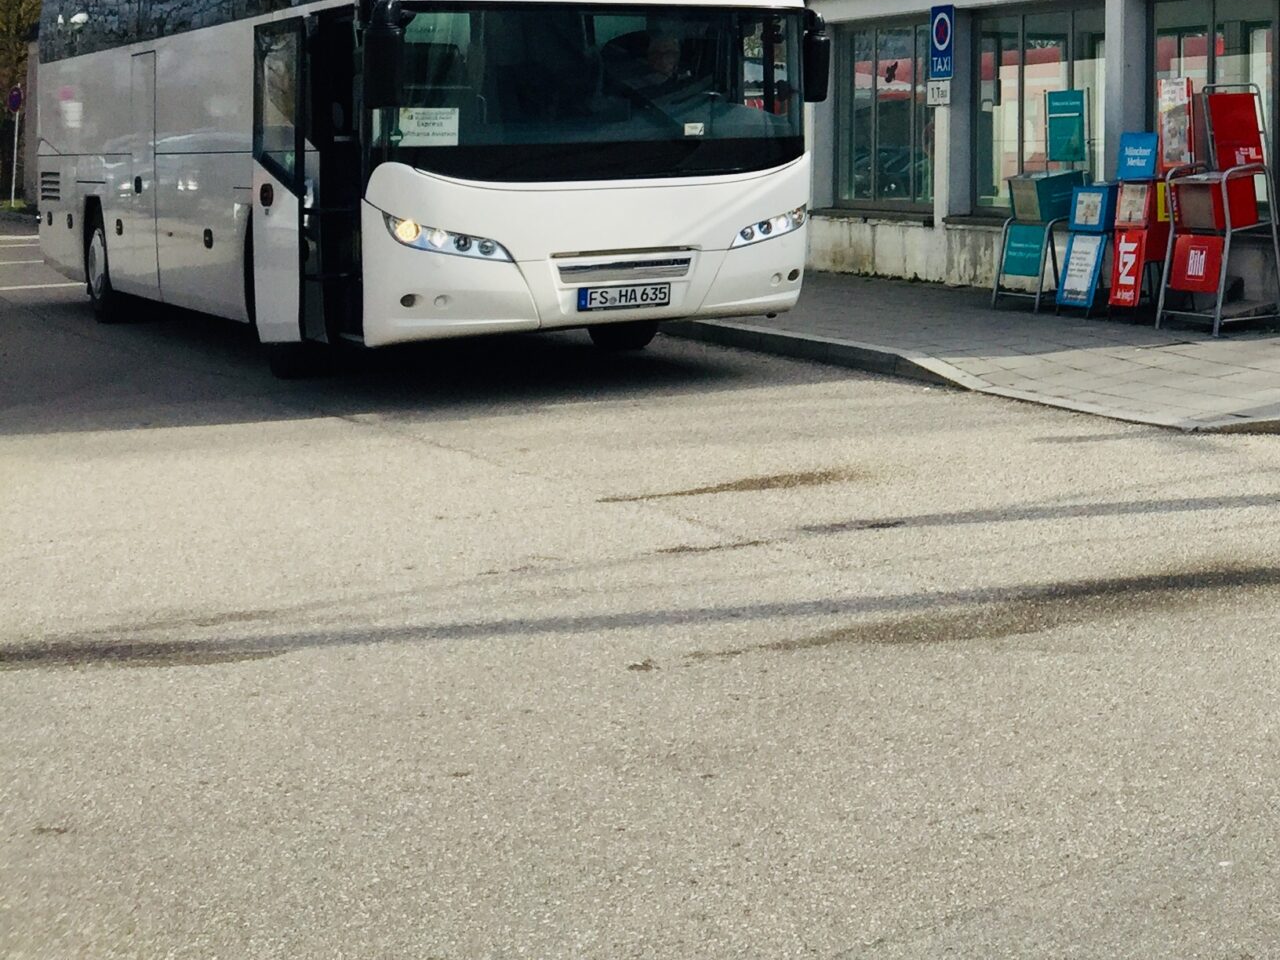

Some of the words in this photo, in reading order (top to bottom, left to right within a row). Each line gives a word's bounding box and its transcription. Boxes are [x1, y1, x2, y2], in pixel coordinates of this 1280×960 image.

[932, 56, 951, 72] TAXI
[1118, 233, 1138, 285] tz
[1187, 249, 1206, 276] Bild
[588, 290, 609, 306] FS
[618, 288, 638, 303] HA
[640, 286, 667, 302] 635
